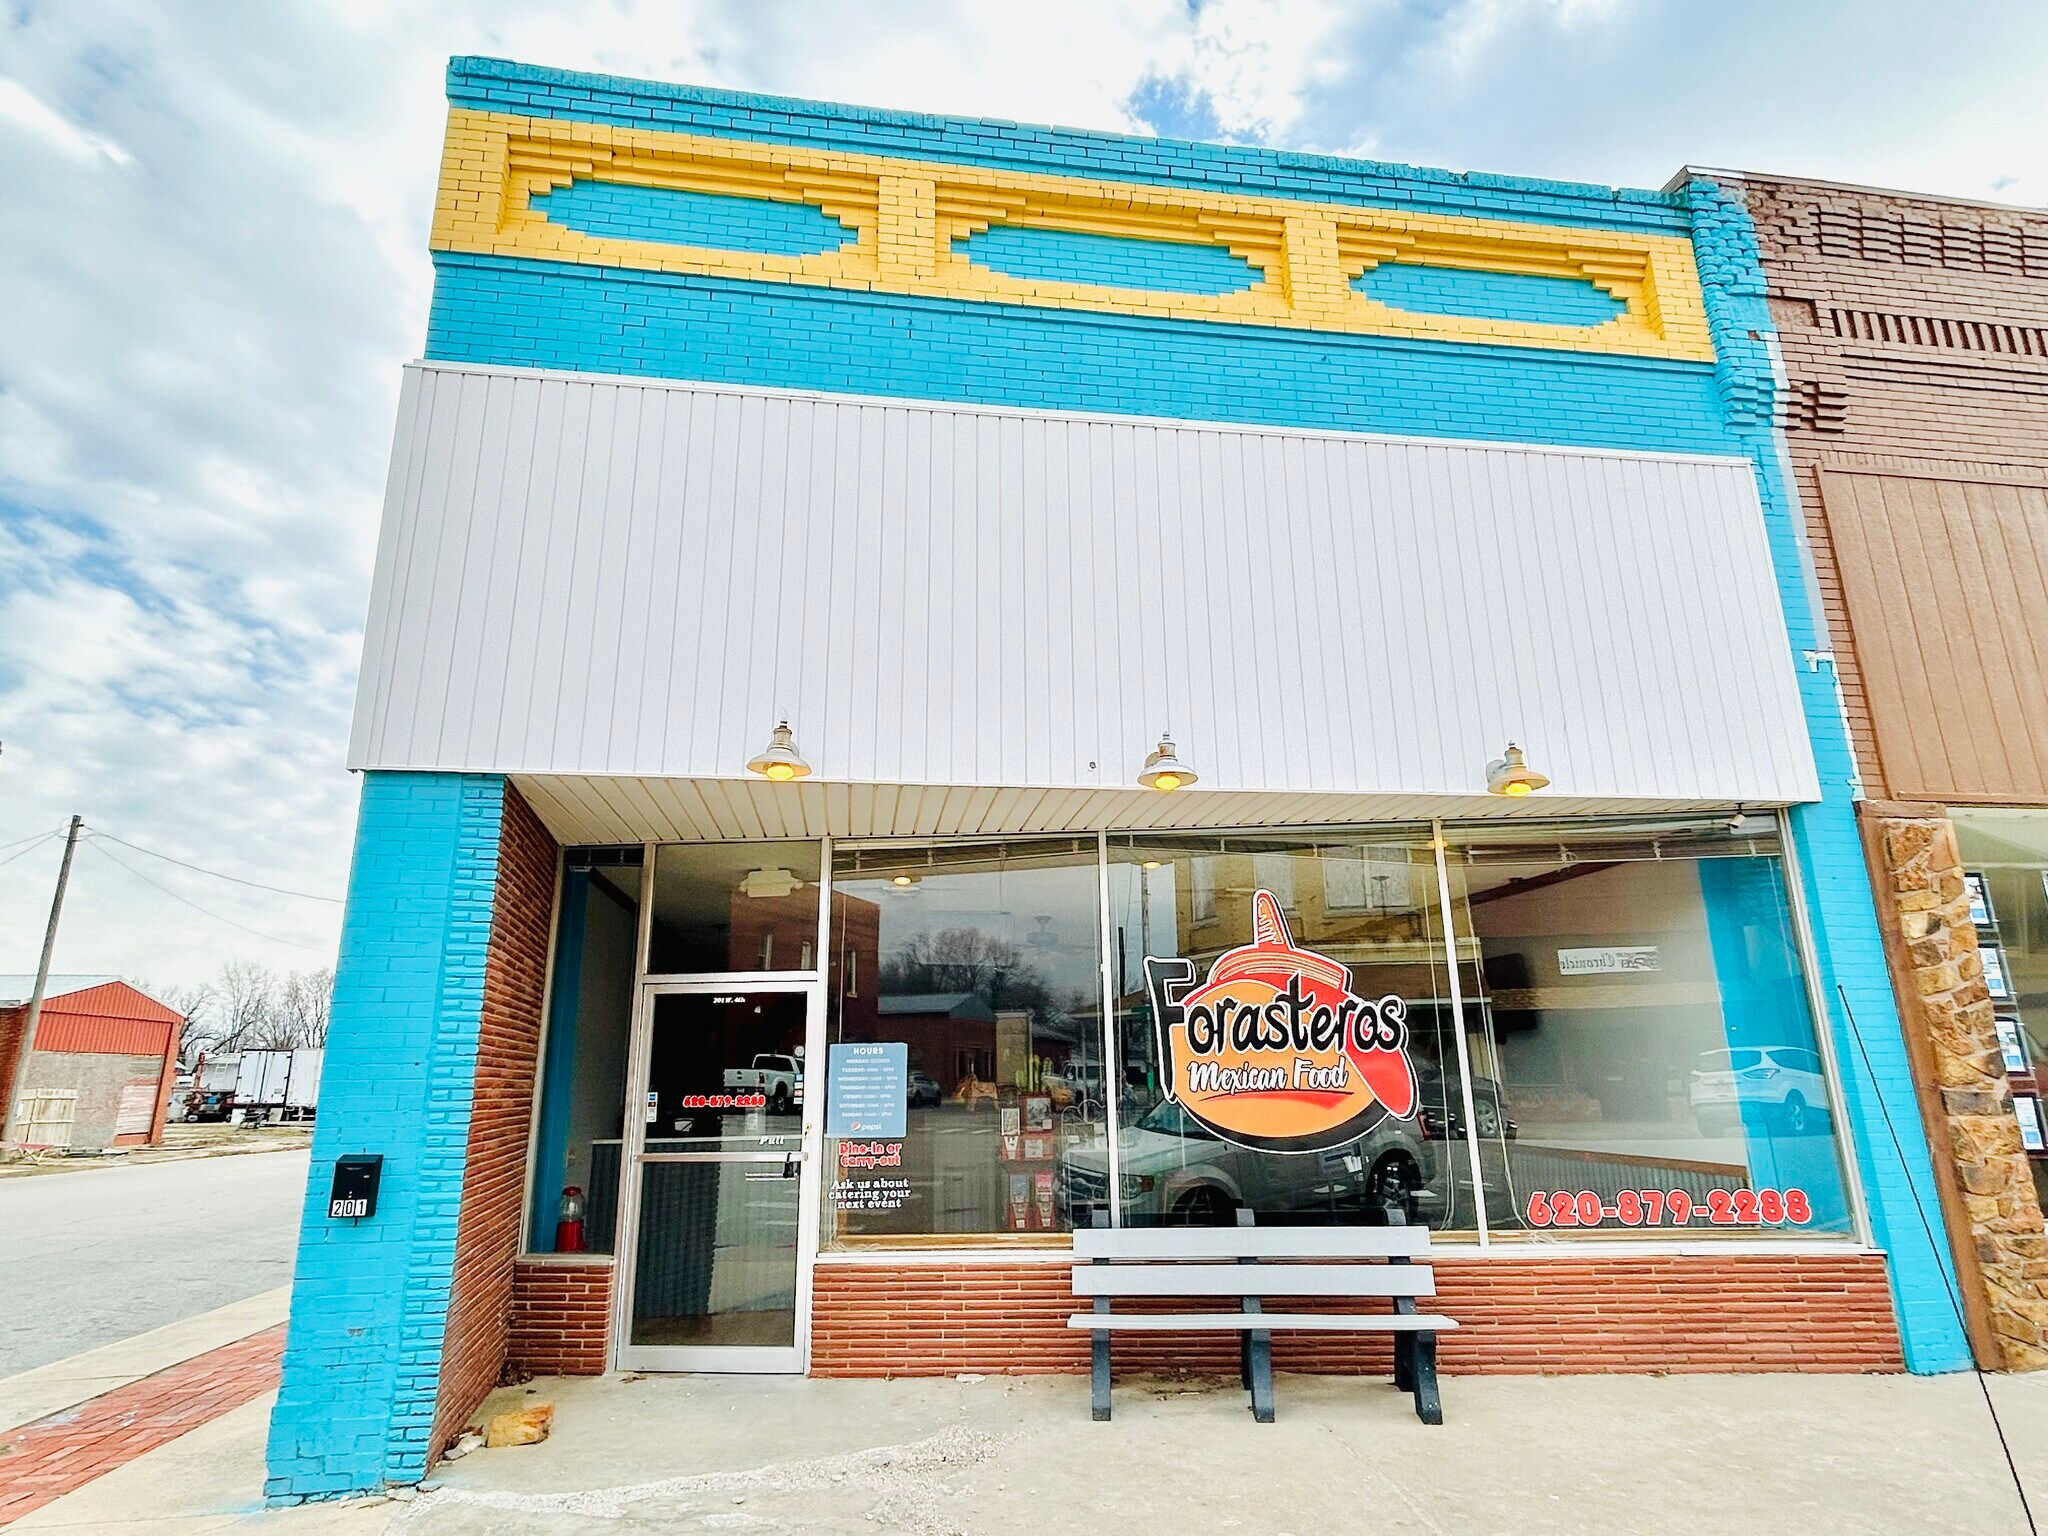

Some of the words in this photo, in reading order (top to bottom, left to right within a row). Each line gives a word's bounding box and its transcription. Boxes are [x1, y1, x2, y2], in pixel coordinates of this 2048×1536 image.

[1145, 957, 1409, 1103] Forasteros
[853, 1047, 884, 1055] HOURS
[1187, 1061, 1288, 1095] Mexican
[1292, 1057, 1349, 1089] Food
[759, 1136, 785, 1145] Pull
[886, 1144, 902, 1154] or
[841, 1154, 901, 1169] Carry-out
[831, 1179, 854, 1189] Ask
[857, 1181, 871, 1189] us
[873, 1178, 909, 1188] about
[828, 1188, 880, 1201] catering
[882, 1190, 911, 1200] your
[333, 1200, 367, 1216] 201
[837, 1200, 864, 1209] next
[867, 1199, 902, 1208] event
[1527, 1188, 1812, 1226] 620-879-2288
